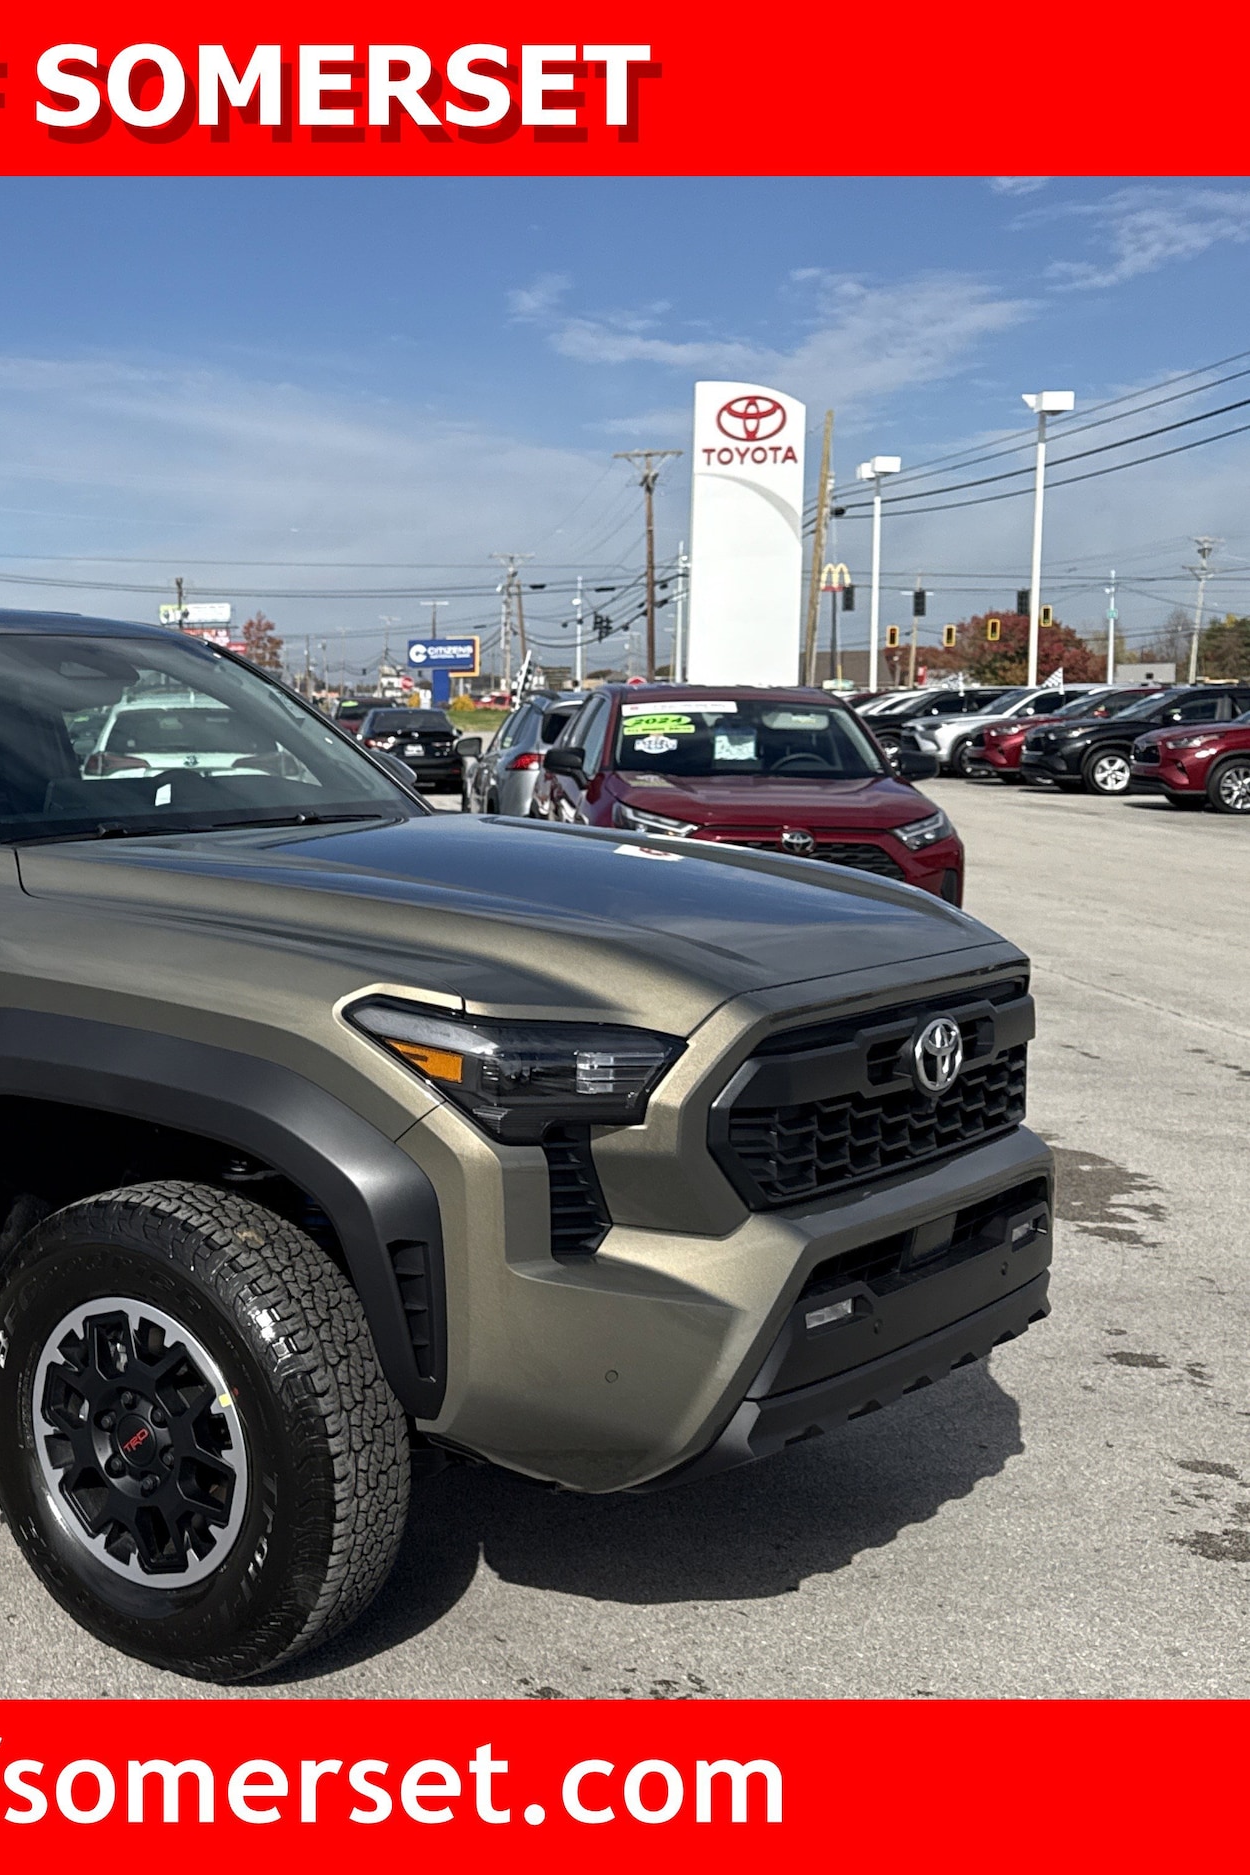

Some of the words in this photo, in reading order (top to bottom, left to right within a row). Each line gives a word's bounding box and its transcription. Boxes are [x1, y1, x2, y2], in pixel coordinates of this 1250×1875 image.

[702, 445, 798, 466] TOYOTA
[632, 717, 683, 726] 2024
[123, 1428, 150, 1452] TRD
